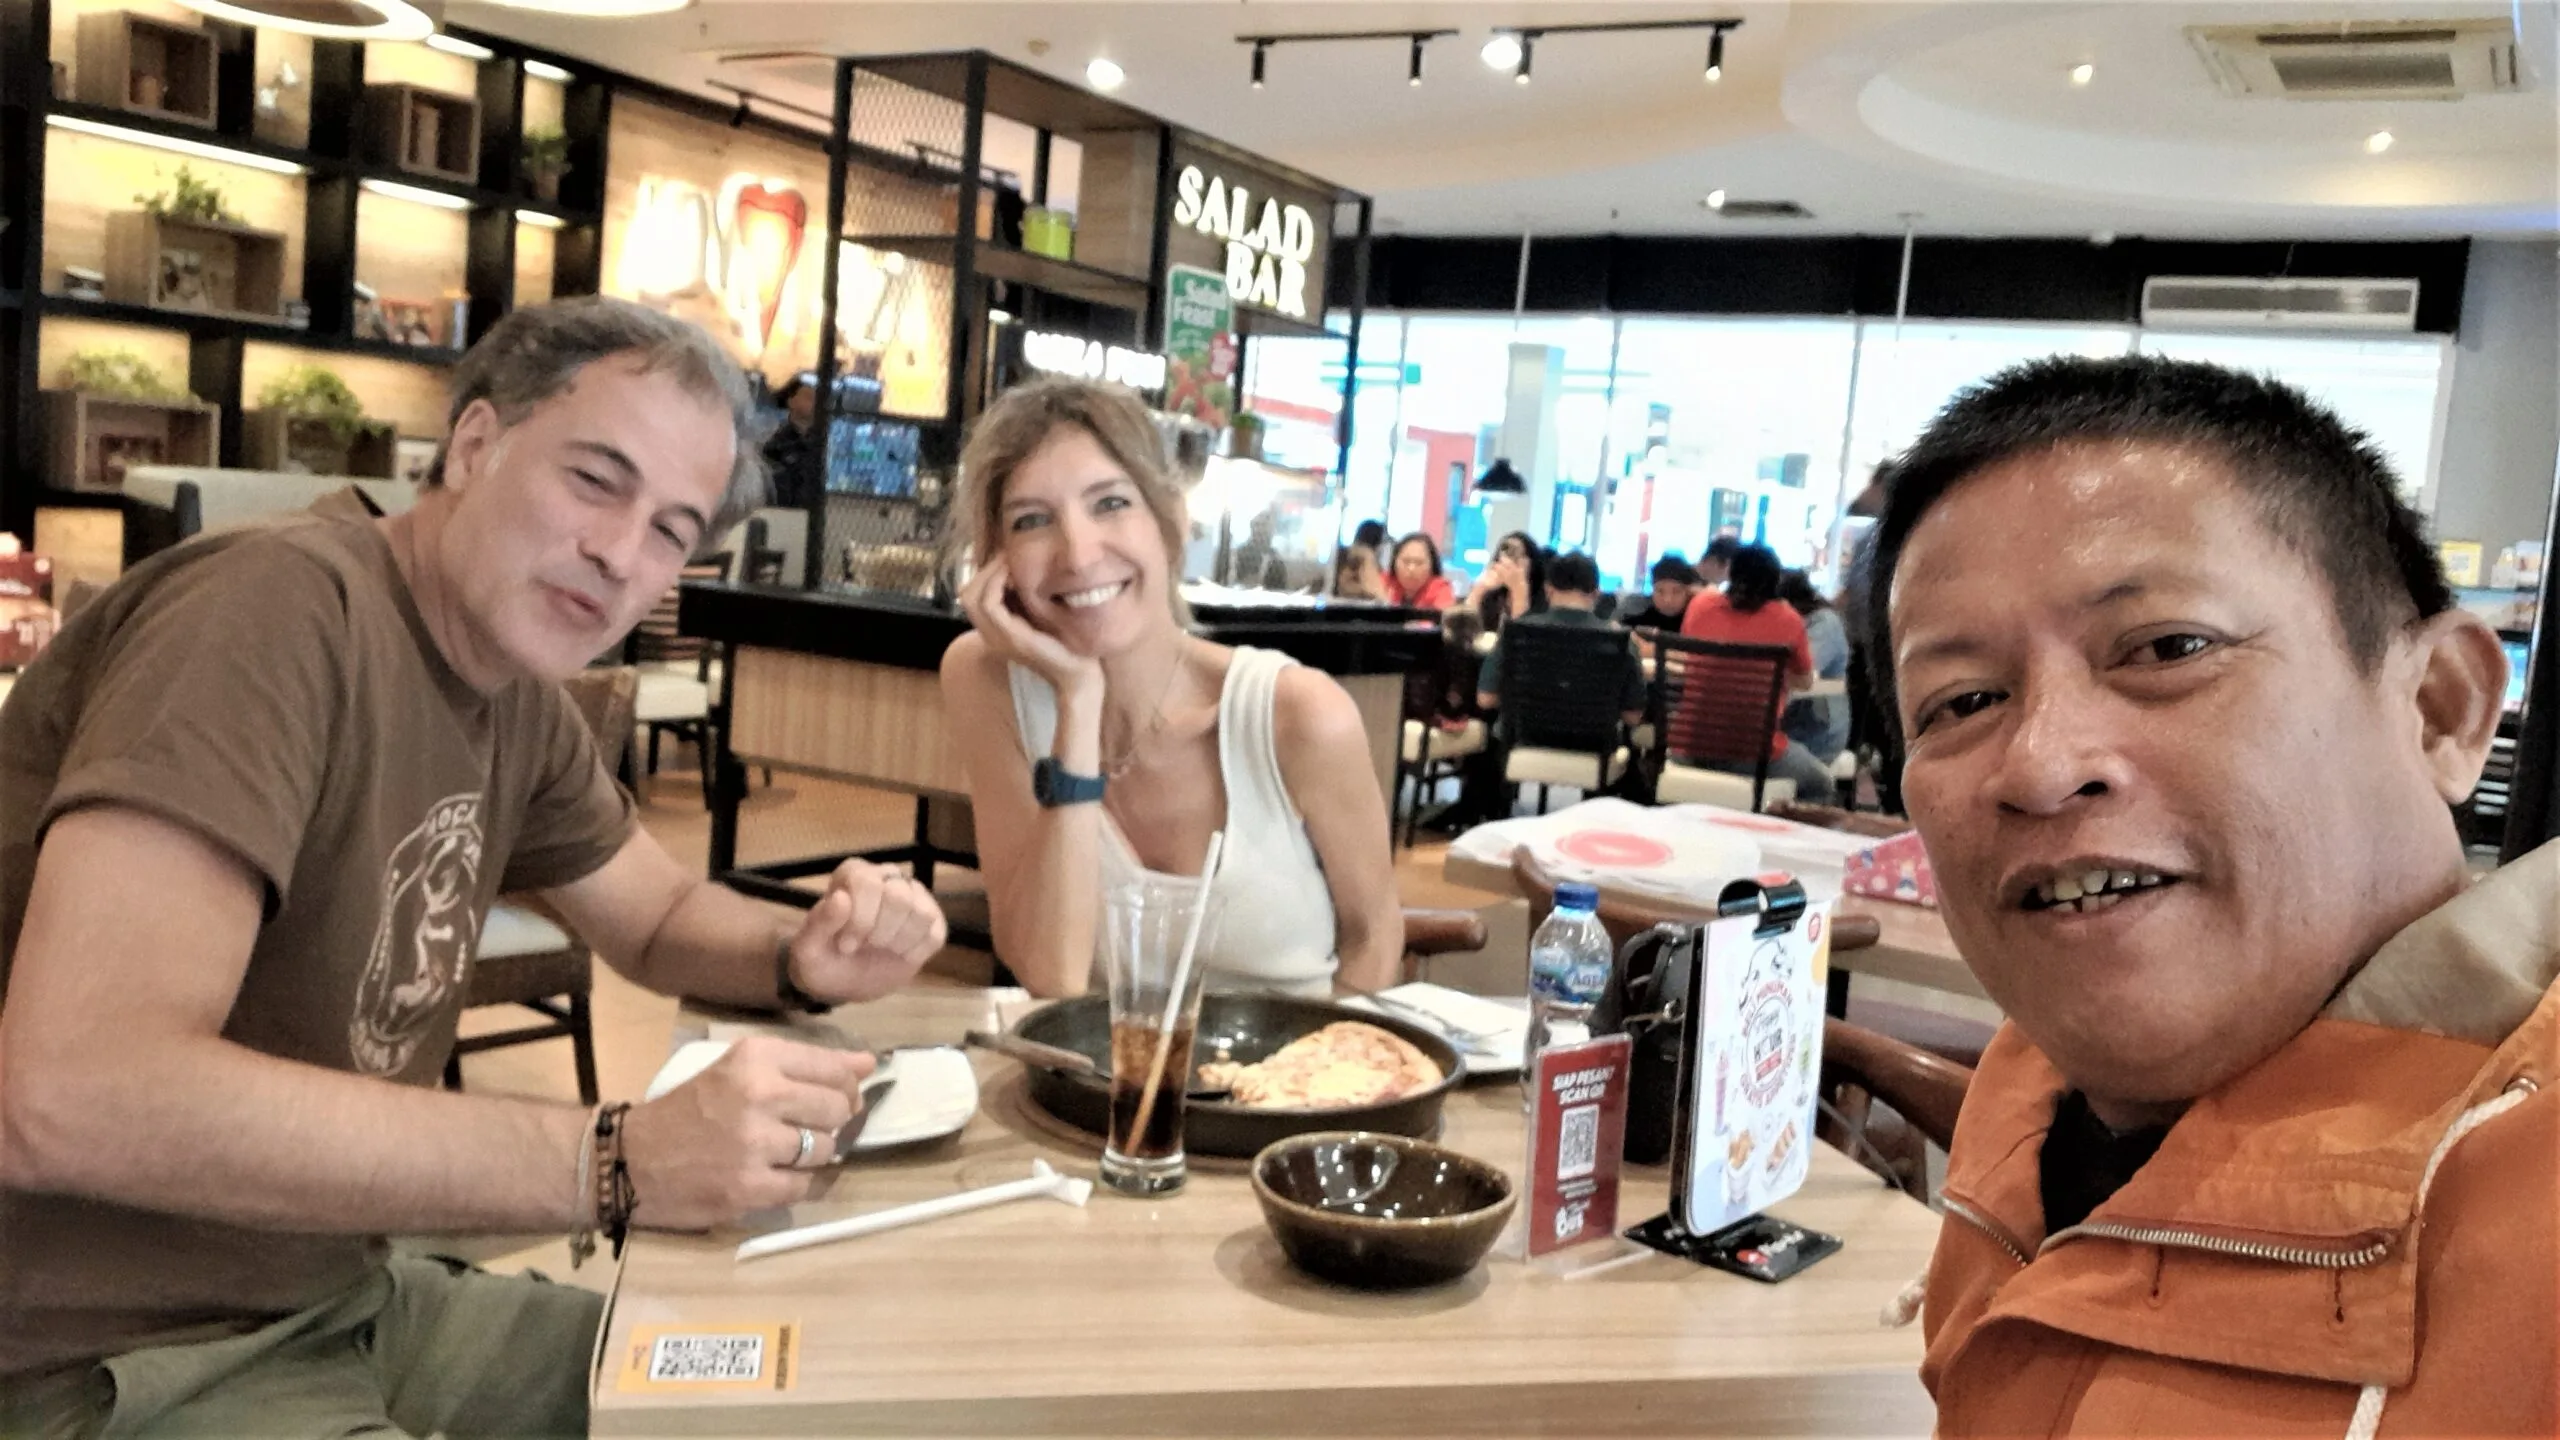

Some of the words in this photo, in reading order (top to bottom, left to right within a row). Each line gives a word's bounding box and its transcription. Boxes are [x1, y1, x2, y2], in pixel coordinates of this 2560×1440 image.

[1174, 164, 1314, 263] SALAD
[1225, 240, 1306, 318] BAR
[1559, 1086, 1590, 1105] SCAN
